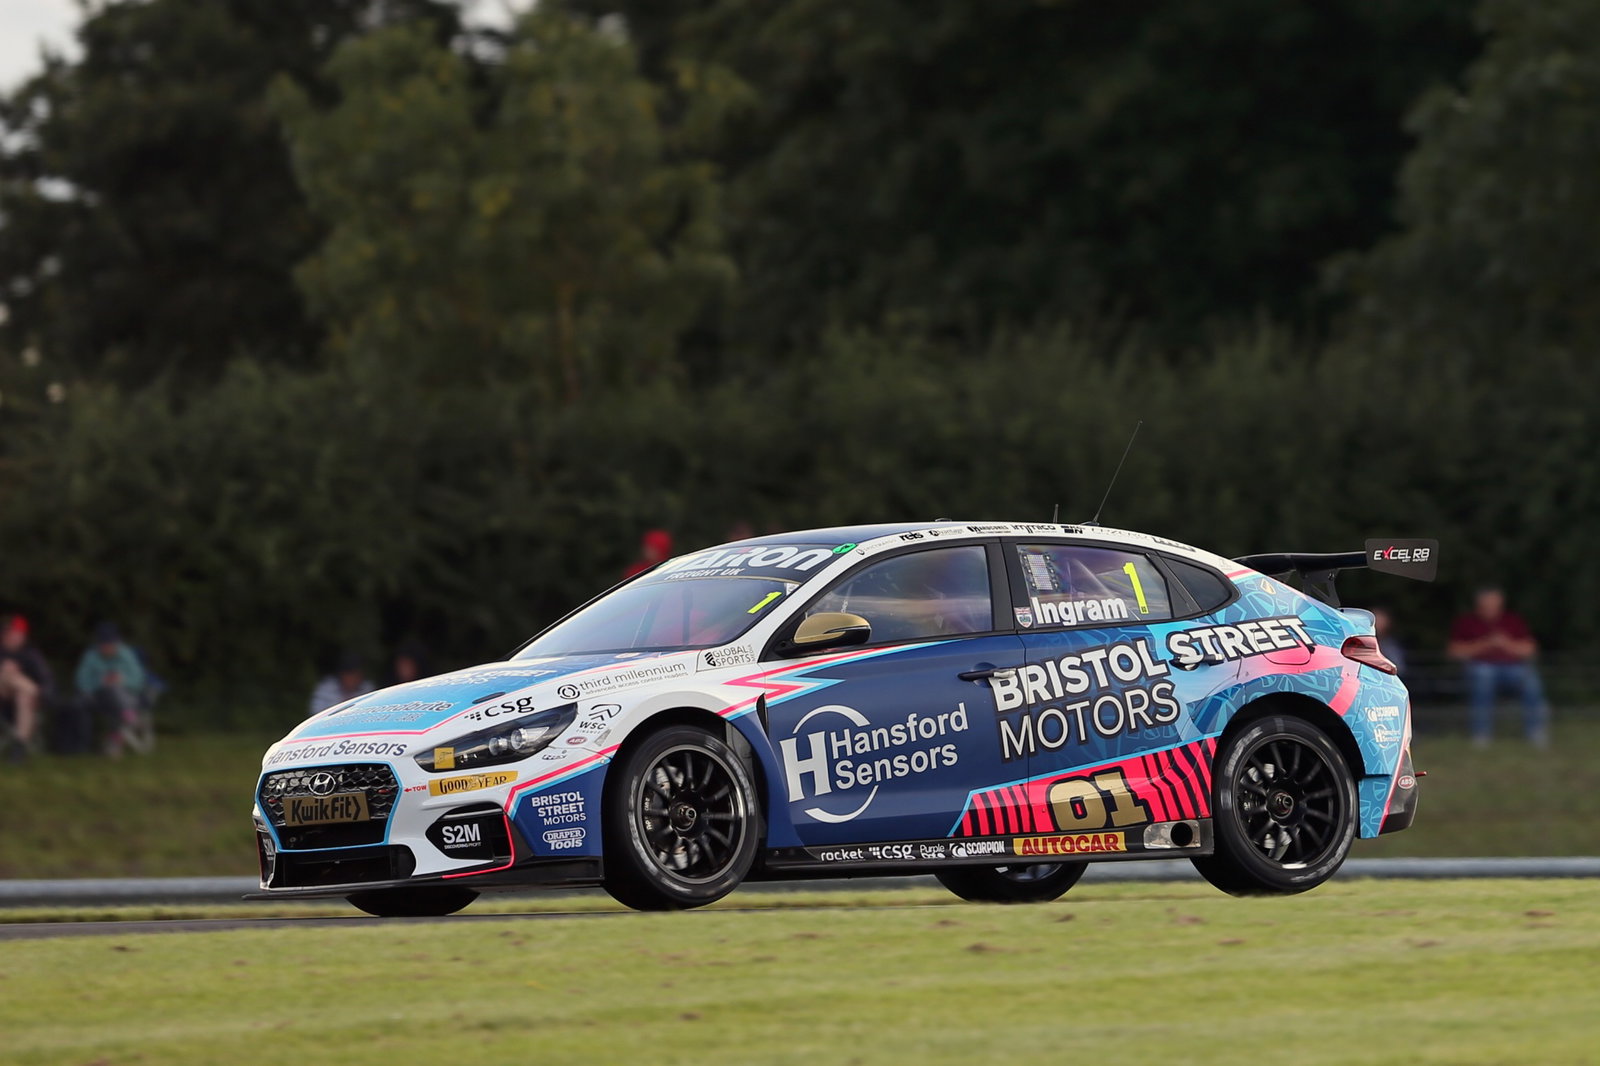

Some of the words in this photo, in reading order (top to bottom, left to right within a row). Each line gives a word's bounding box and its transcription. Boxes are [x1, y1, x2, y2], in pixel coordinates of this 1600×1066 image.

[720, 568, 745, 576] UK
[1122, 562, 1149, 614] 1
[747, 591, 782, 614] 1
[1031, 596, 1129, 626] Ingram
[712, 645, 748, 658] GLOBAL
[715, 653, 752, 667] SPORTS
[992, 639, 1169, 712] BRISTOL
[1168, 617, 1315, 664] STREET
[580, 675, 611, 690] third
[614, 662, 686, 682] millennium
[484, 696, 535, 718] csg
[580, 721, 607, 730] WSC
[830, 702, 969, 759] Hansford
[1000, 682, 1180, 760] MOTORS
[268, 742, 335, 765] Hansford
[334, 740, 408, 756] Sensors
[835, 743, 958, 790] Sensors
[532, 792, 584, 807] BRISTOL
[538, 802, 584, 817] STREET
[1050, 771, 1147, 831] 01
[544, 813, 587, 825] MOTORS
[442, 823, 481, 844] S2M
[547, 831, 582, 841] DRAPER
[1022, 833, 1119, 855] AUTOCAR
[550, 839, 583, 850] Tools
[820, 849, 864, 861] rocket
[881, 844, 913, 860] csg
[967, 841, 1005, 854] SCORPION
